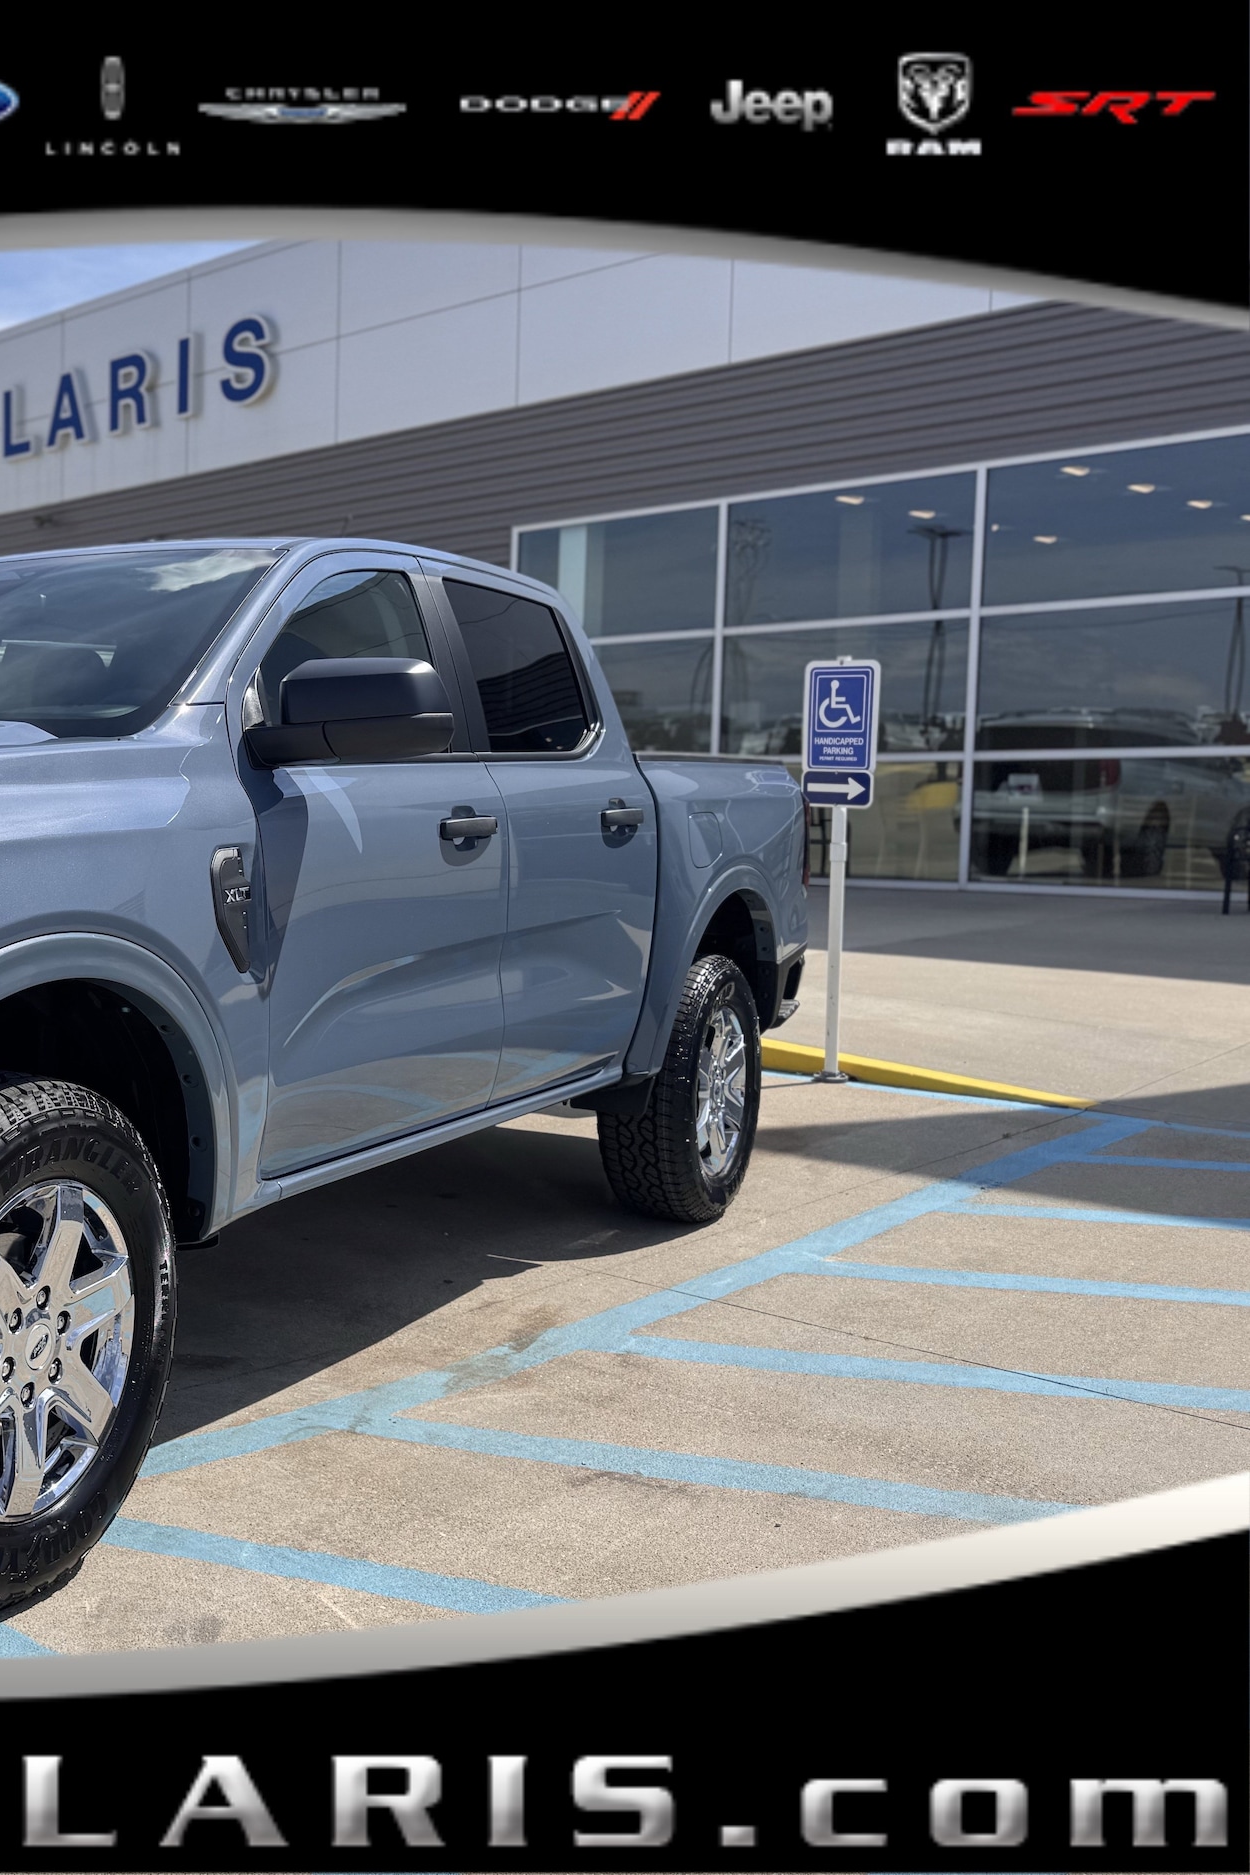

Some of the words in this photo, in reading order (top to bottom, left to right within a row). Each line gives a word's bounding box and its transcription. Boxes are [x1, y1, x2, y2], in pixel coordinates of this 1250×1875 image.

[814, 737, 864, 745] HANDICAPPED
[823, 747, 854, 755] PARKING
[225, 887, 249, 903] XLT
